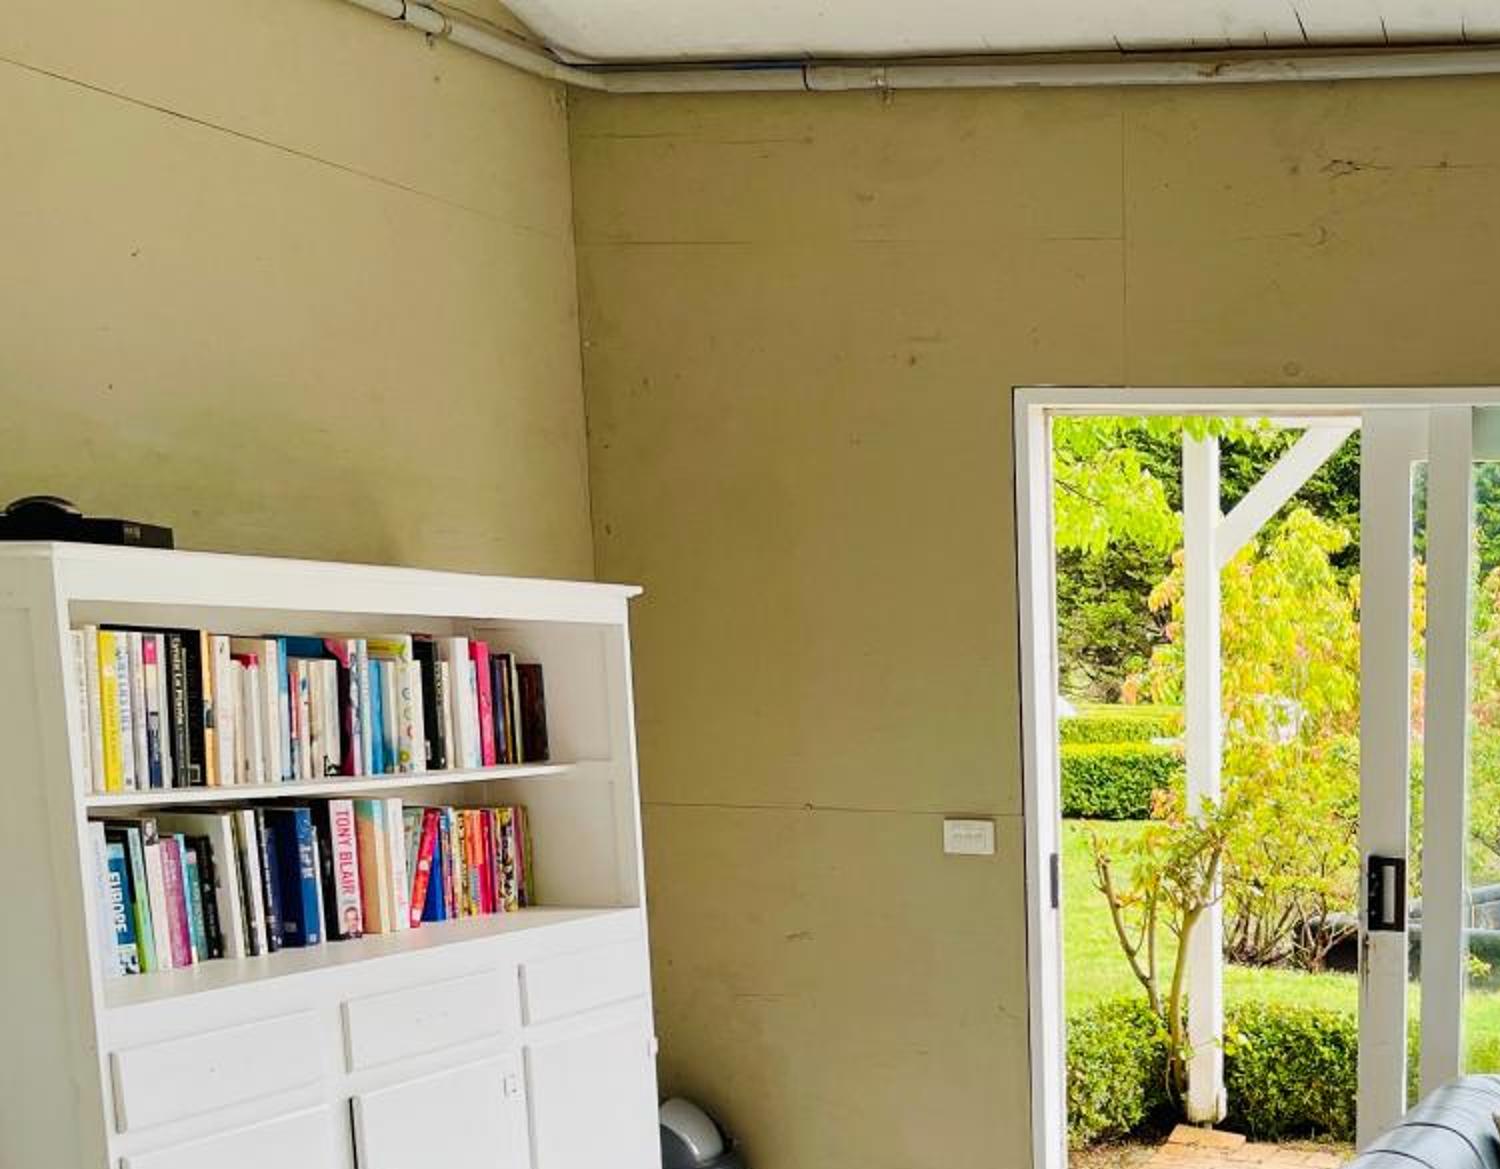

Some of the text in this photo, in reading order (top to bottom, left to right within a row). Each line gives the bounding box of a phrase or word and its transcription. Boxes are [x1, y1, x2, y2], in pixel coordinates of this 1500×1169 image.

[336, 811, 355, 896] TONY BLAIR
[109, 871, 129, 934] EUROPE
